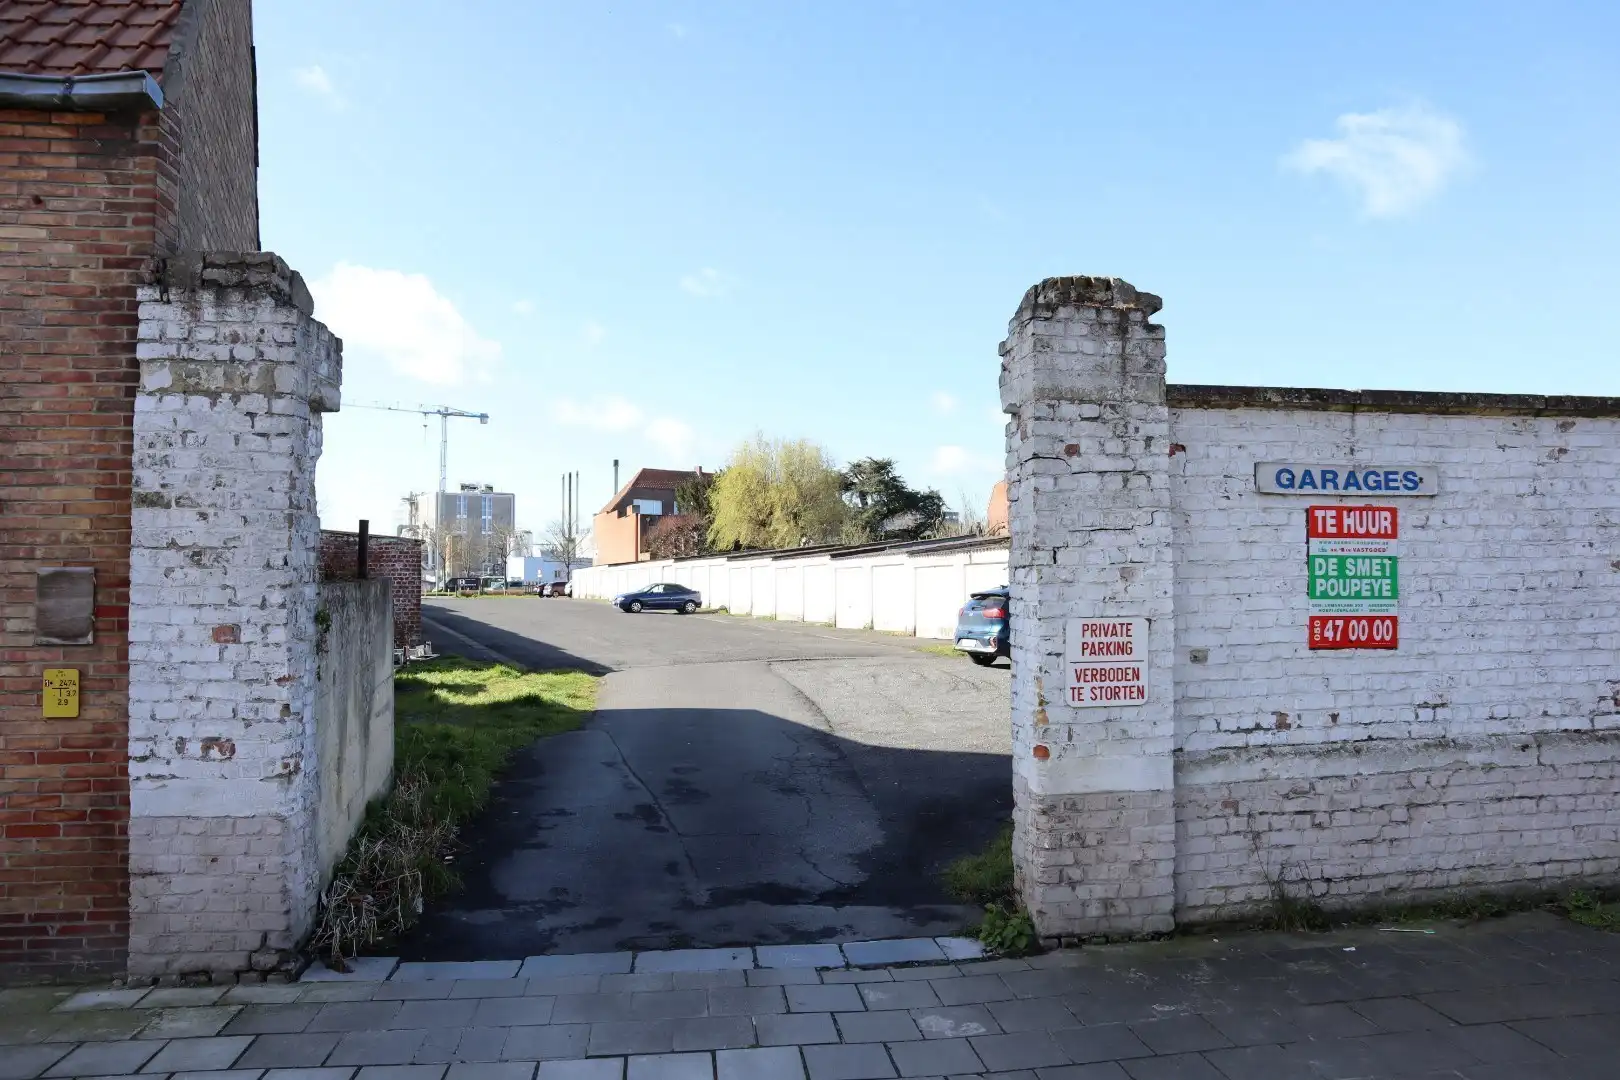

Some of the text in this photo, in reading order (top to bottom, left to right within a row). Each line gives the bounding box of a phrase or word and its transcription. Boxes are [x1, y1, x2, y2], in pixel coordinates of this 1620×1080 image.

[1275, 468, 1419, 491] GARAGES
[1314, 510, 1392, 534] TE HUUR
[1314, 558, 1392, 577] DE SMET
[1315, 578, 1392, 597] POUPEYE
[1082, 623, 1133, 638] PRIVATE
[1313, 619, 1393, 641] 050 47 00 00
[1081, 641, 1133, 656] PARKING
[1074, 667, 1140, 683] VERBODEN
[1070, 685, 1145, 701] TE STORTEN
